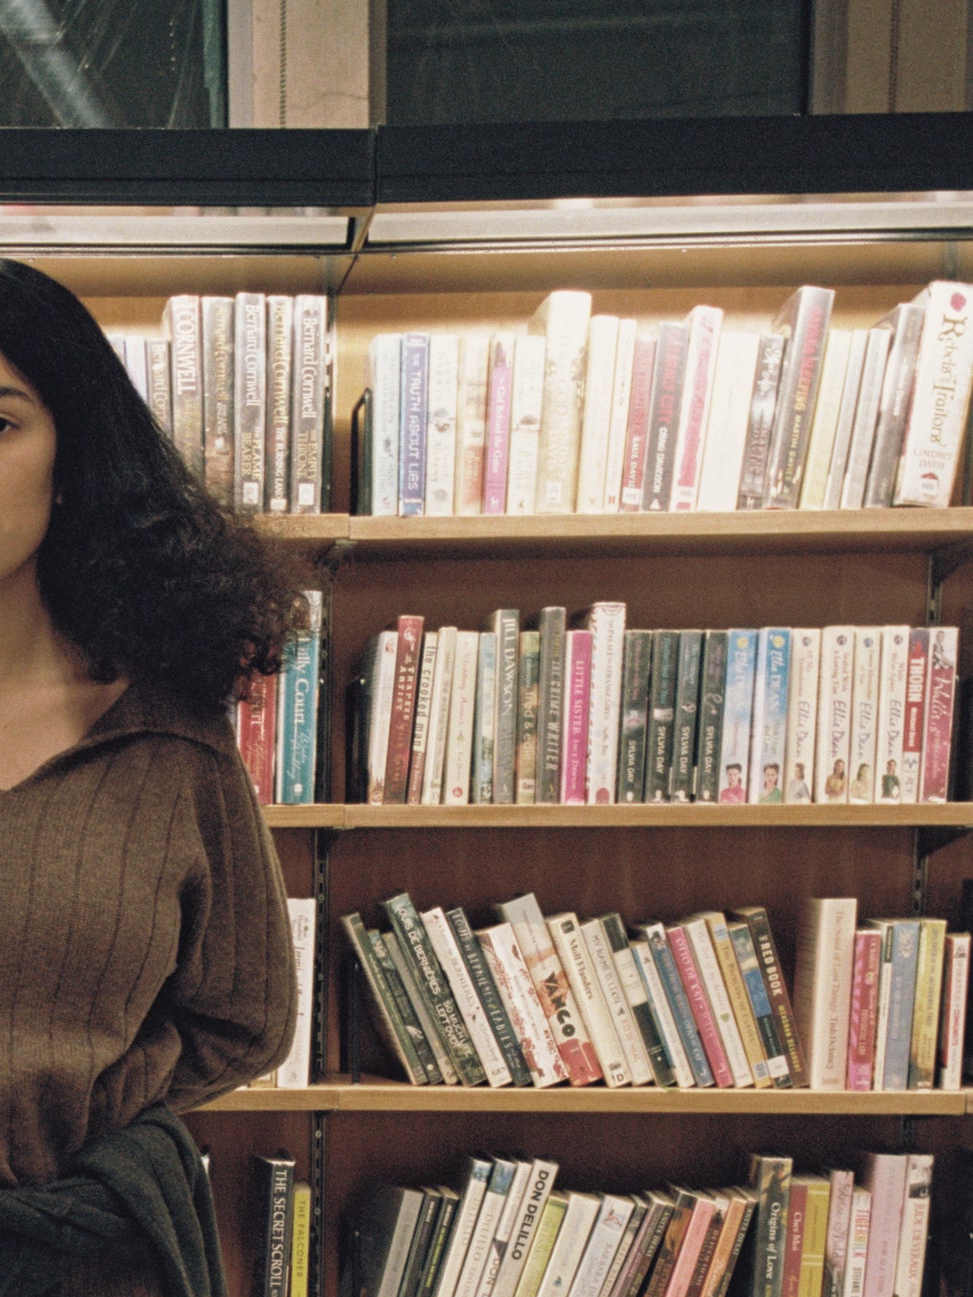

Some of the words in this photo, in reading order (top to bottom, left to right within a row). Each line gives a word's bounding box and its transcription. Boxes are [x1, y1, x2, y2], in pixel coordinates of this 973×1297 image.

[246, 303, 260, 352] Bernard
[274, 303, 288, 360] Bernard
[301, 317, 318, 364] Bernard
[176, 310, 196, 395] CORNWELL
[245, 354, 260, 406] Cornwell
[272, 362, 289, 424] Cornwell
[301, 367, 317, 418] Cornwell
[410, 371, 421, 411] TRUTH
[276, 427, 284, 441] THE
[409, 415, 419, 460] ABOUT
[658, 428, 666, 452] CRAIG
[790, 415, 800, 448] MARTIN
[241, 432, 252, 476] BEARER
[251, 439, 261, 480] FLAME
[275, 443, 284, 476] BURNING
[297, 433, 308, 479] THRONE
[308, 443, 318, 481] EMPTY
[408, 463, 419, 490] LIES
[653, 453, 663, 493] DAVIDSON
[502, 618, 517, 643] JILL
[424, 645, 436, 664] the
[502, 648, 516, 716] DAWSON
[575, 660, 584, 695] LITTLE
[908, 657, 925, 702] THORN
[294, 678, 309, 725] Court
[416, 669, 432, 717] crooked
[549, 680, 560, 716] CRIME
[573, 699, 583, 735] SISTER
[797, 700, 810, 727] Ellie
[832, 700, 846, 728] Ellie
[859, 702, 871, 731] Ellie
[888, 700, 902, 727] Ellie
[413, 722, 426, 747] man
[546, 721, 559, 770] WRITER
[681, 726, 690, 754] SYLVIA
[706, 725, 714, 754] SYLVIA
[628, 740, 636, 766] SYLVIA
[656, 756, 664, 774] DAY
[679, 756, 688, 774] DAY
[704, 756, 713, 774] DAY
[627, 768, 635, 784] DAY
[408, 931, 419, 944] DE
[761, 943, 774, 963] RED
[568, 938, 582, 960] Moll
[576, 963, 594, 1000] Flanders
[766, 967, 783, 996] BOOK
[436, 1004, 448, 1024] LEFT
[444, 1000, 455, 1012] SO
[448, 1014, 464, 1038] MUCH
[274, 1169, 287, 1193] THE
[531, 1169, 549, 1202] DON
[272, 1197, 286, 1242] SECRET
[297, 1200, 306, 1219] THE
[656, 1212, 669, 1234] ANITA
[741, 1209, 753, 1230] ANITA
[768, 1202, 780, 1240] Origins
[914, 1203, 926, 1227] JUDE
[511, 1204, 537, 1261] DELILLO
[646, 1236, 660, 1258] DESAI
[732, 1233, 746, 1256] DESAI
[791, 1234, 800, 1251] Moi
[296, 1223, 306, 1278] FALCONER
[767, 1243, 778, 1253] of
[269, 1244, 284, 1288] SCROLL
[766, 1255, 778, 1279] Love
